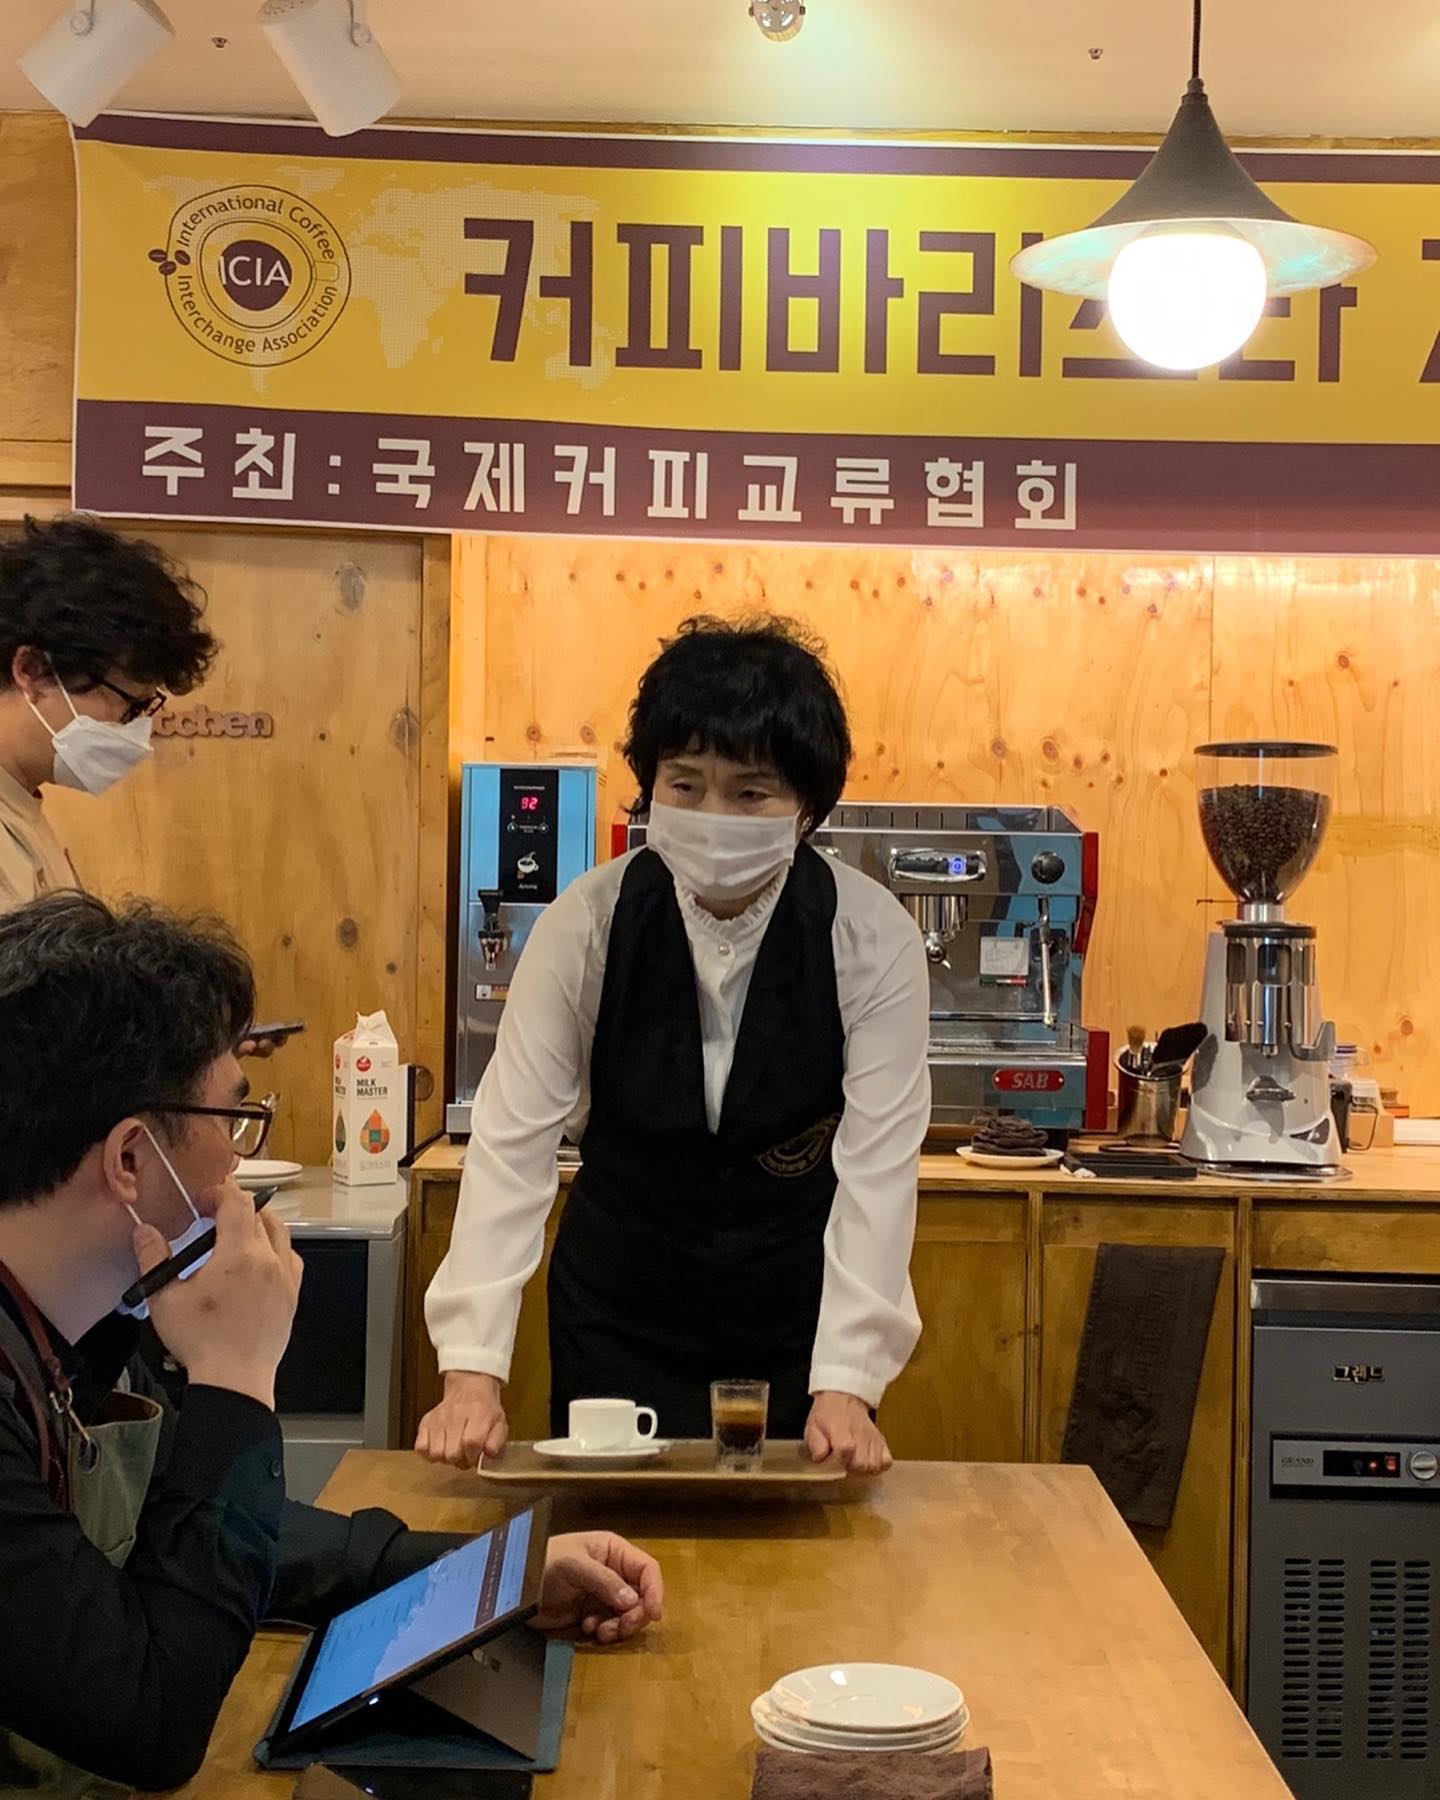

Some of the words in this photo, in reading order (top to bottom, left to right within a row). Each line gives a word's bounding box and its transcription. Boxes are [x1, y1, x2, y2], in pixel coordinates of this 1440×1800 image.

[176, 195, 284, 248] International
[288, 206, 336, 261] Coffee
[220, 255, 290, 287] ICIA
[177, 274, 256, 355] Interchange
[261, 285, 338, 353] Association
[150, 703, 274, 738] tchen
[356, 1078, 376, 1087] MILK
[356, 1087, 388, 1097] MASTER
[1011, 1072, 1049, 1089] SAB
